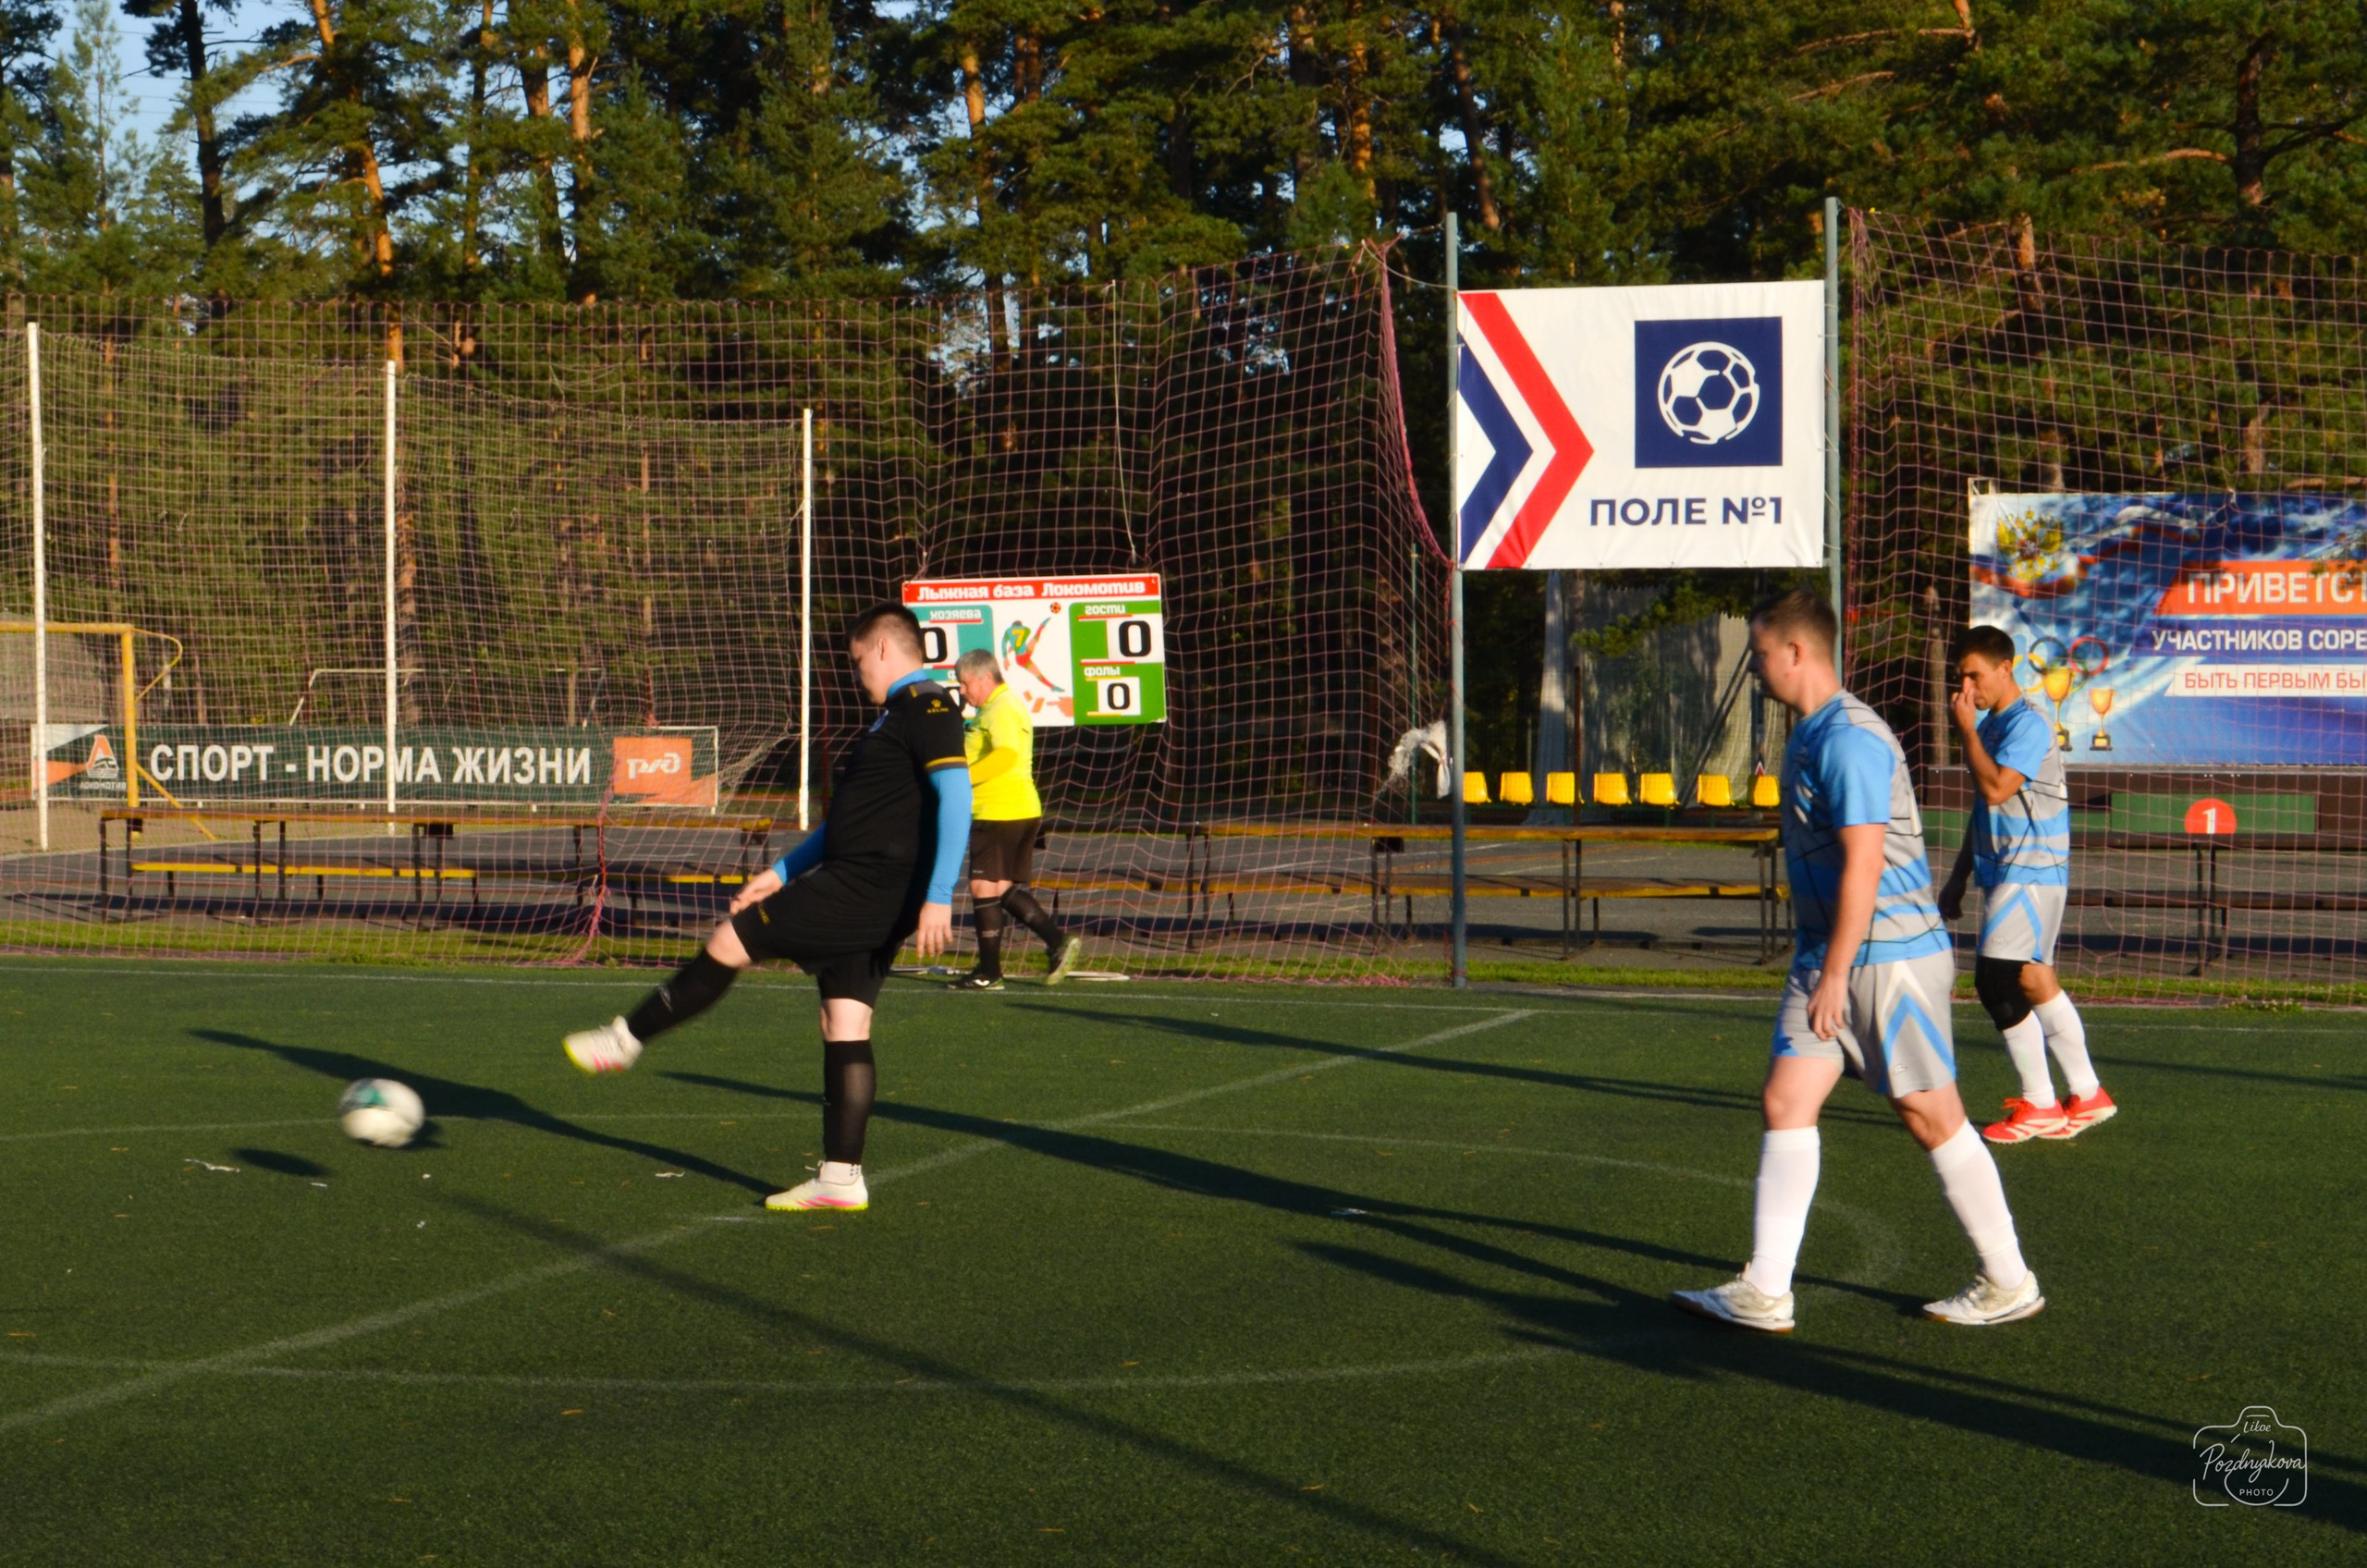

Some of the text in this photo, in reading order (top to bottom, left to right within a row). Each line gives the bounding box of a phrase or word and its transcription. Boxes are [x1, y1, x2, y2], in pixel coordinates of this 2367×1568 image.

[1590, 496, 1783, 526] ПОЛЕ №1
[917, 582, 1146, 601] Лыжная база Локомотив
[929, 608, 982, 620] хозяева
[1085, 604, 1126, 615] гости
[1012, 629, 1025, 647] 7
[1119, 620, 1152, 657] 0
[2152, 629, 2367, 652] УЧАСТНИКОВ СОРЕ
[1084, 667, 1121, 678] фолы
[2184, 672, 2238, 690] БЫТЬ
[2244, 672, 2330, 690] ПЕРВЫМ
[1107, 682, 1131, 710] 0
[150, 744, 275, 781] СПОРТ
[307, 745, 442, 783] НОРМА
[452, 746, 591, 784] ЖИЗНИ
[2202, 806, 2216, 835] 1
